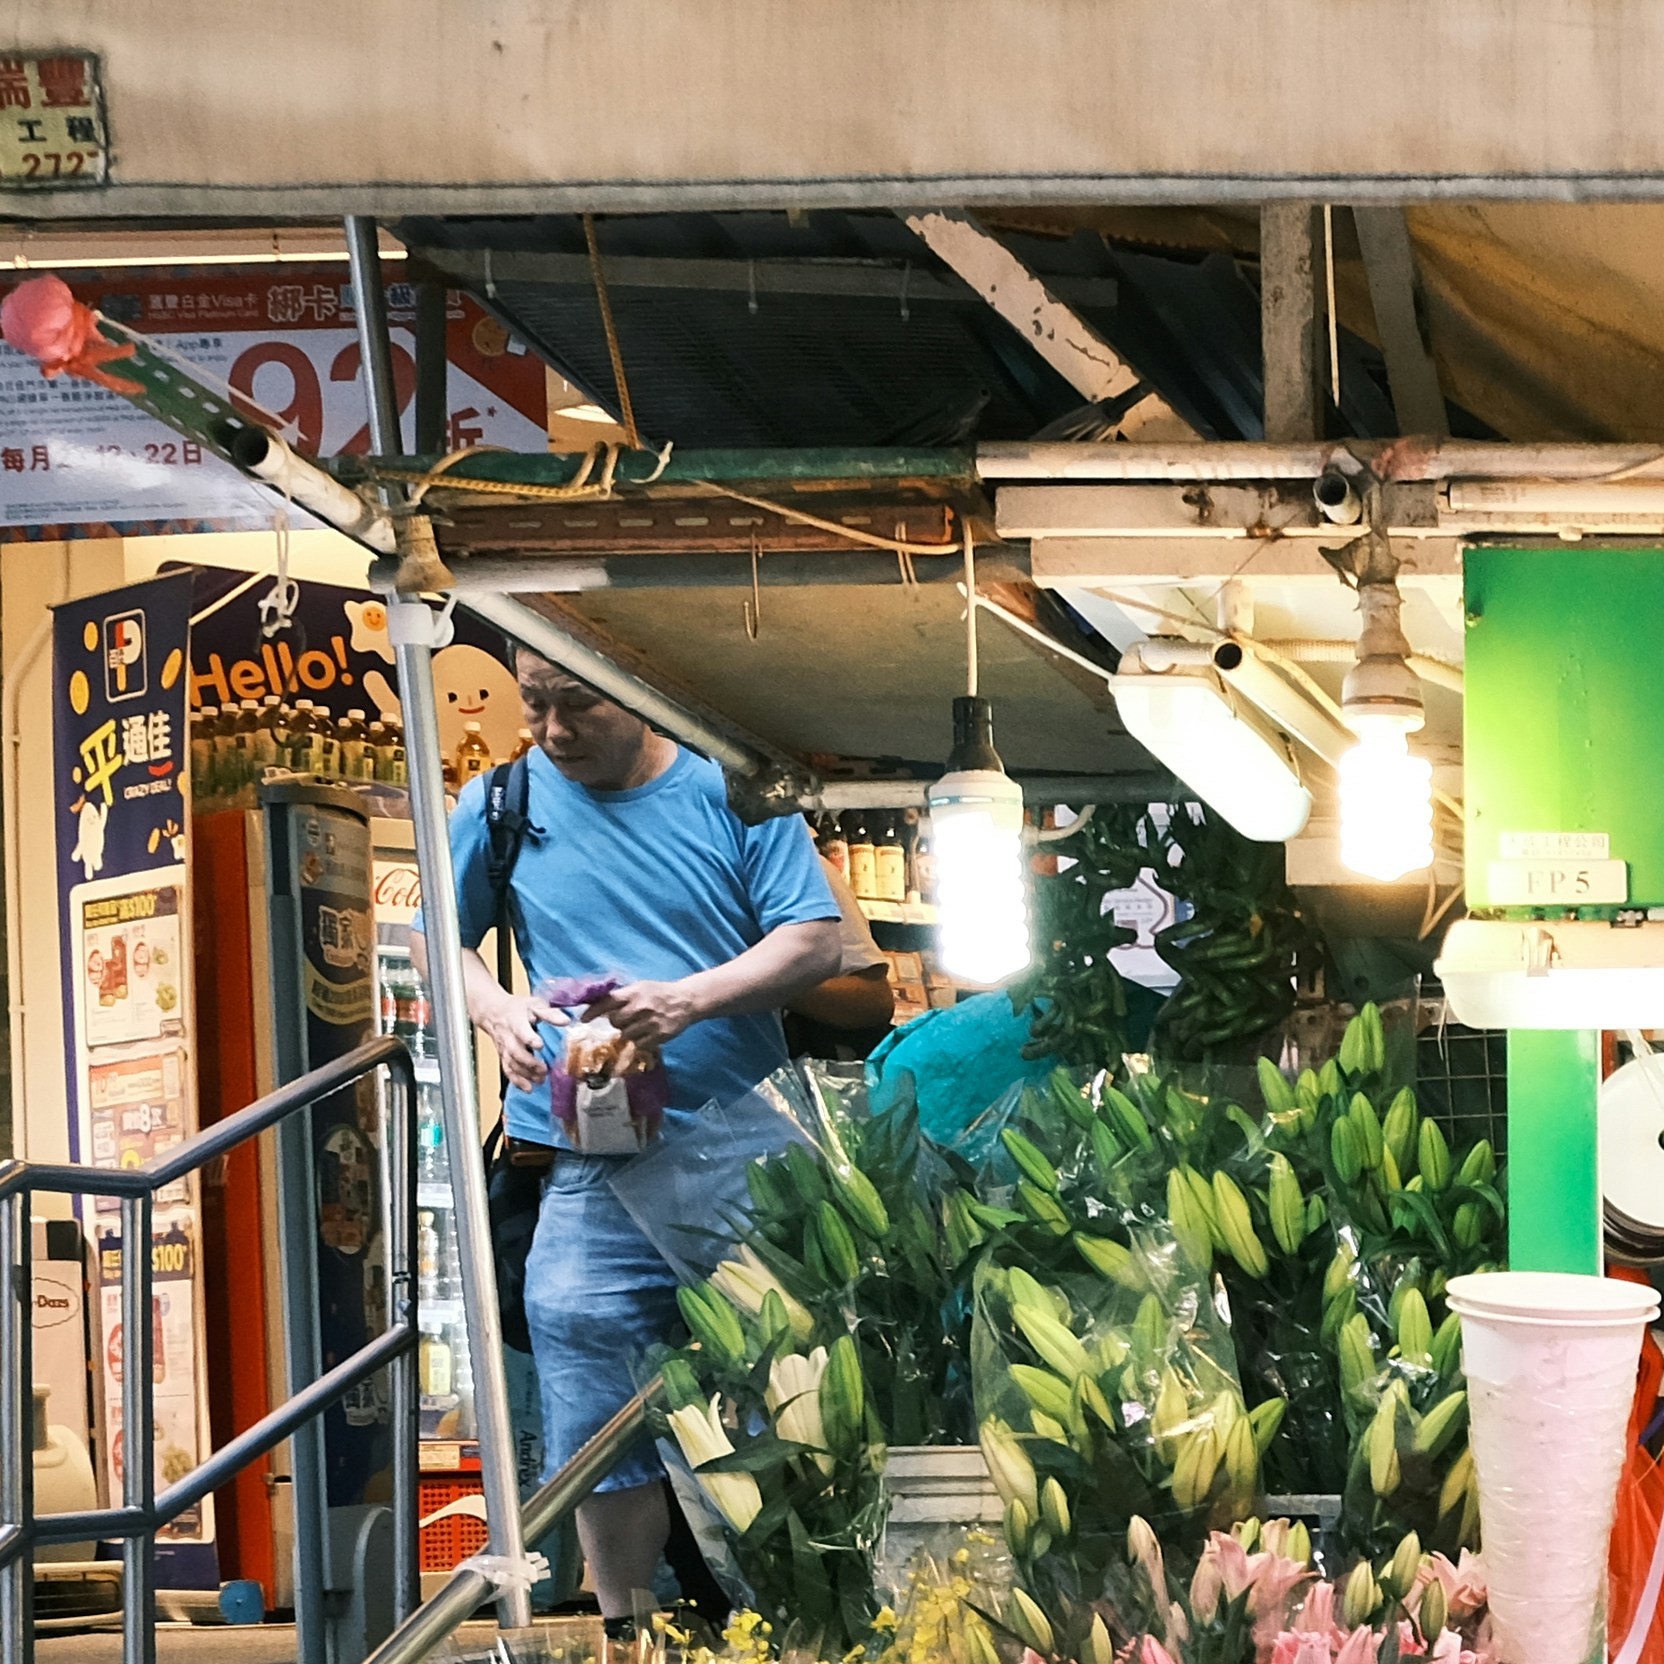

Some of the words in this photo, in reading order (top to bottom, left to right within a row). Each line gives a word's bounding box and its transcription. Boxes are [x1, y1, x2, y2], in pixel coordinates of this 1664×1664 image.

[21, 151, 99, 177] 272
[190, 635, 354, 707] Hello!
[79, 718, 123, 806] 平
[1575, 871, 1591, 894] 5
